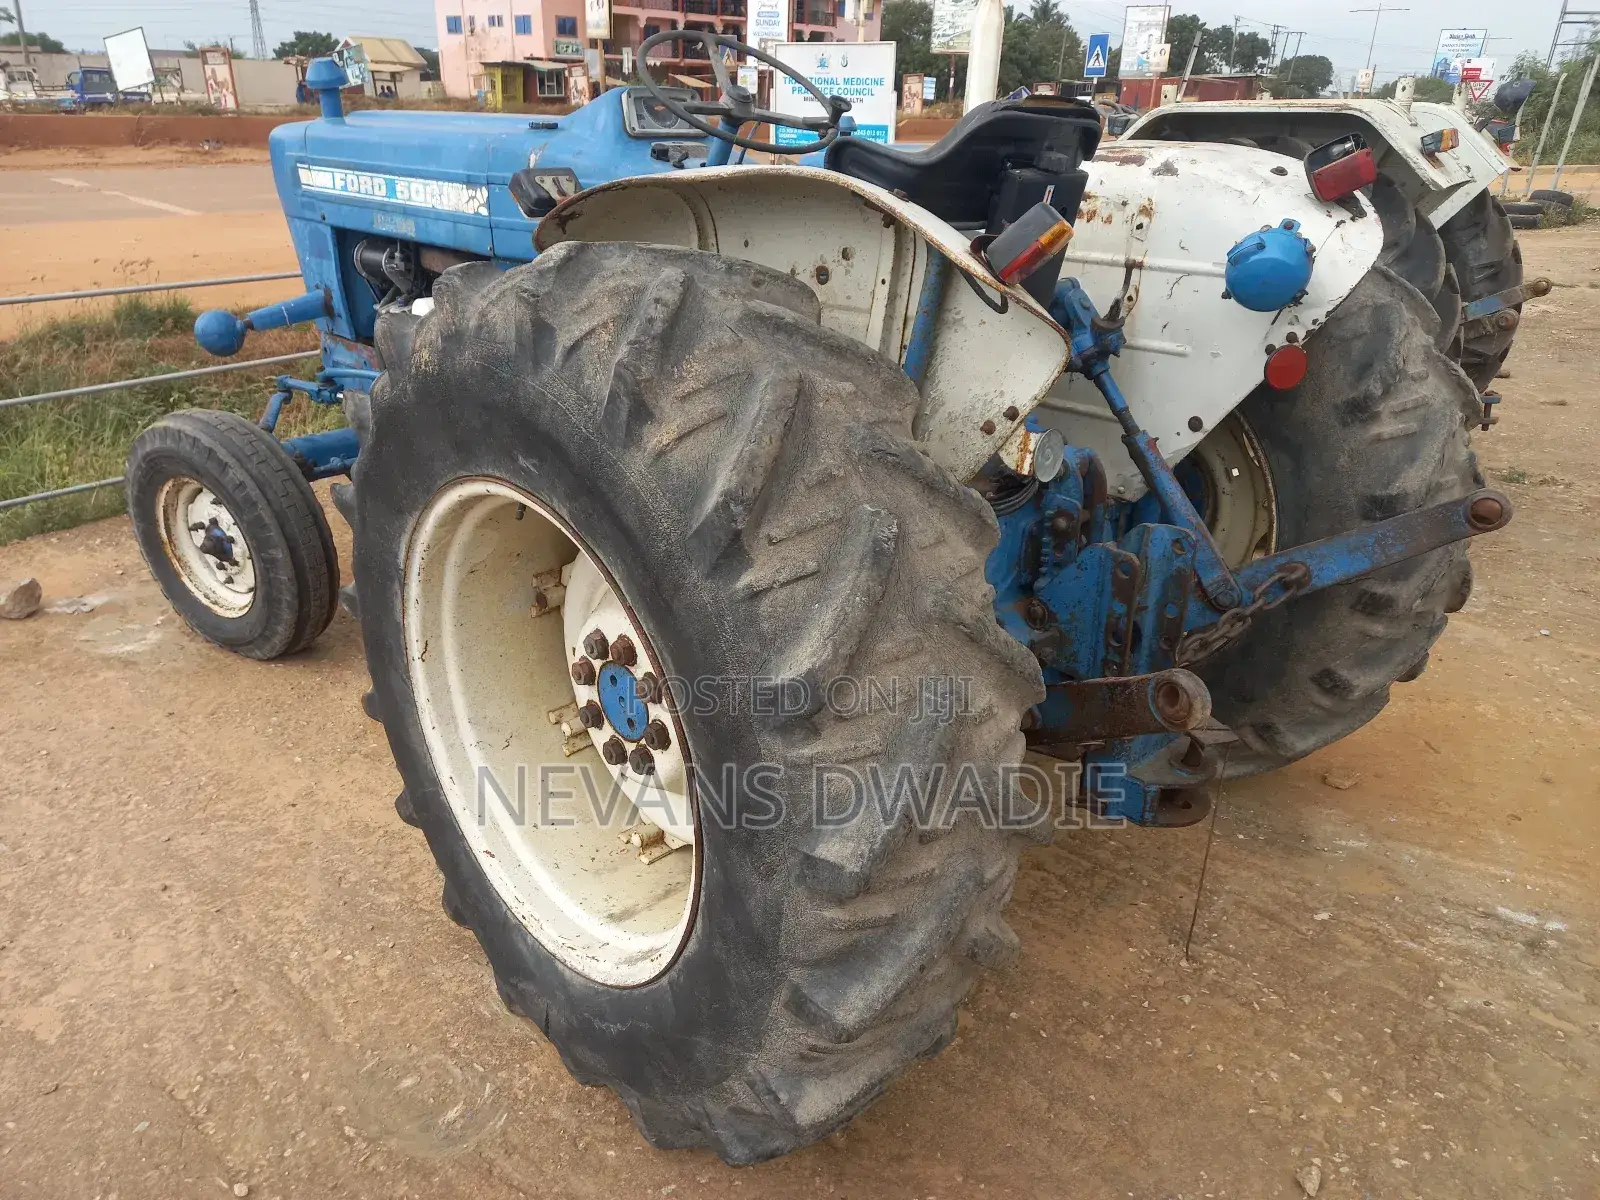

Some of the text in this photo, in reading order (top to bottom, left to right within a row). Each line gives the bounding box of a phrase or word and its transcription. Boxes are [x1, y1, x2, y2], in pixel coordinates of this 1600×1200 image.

[755, 19, 781, 27] SUNDAY
[783, 76, 885, 87] TRTIONAL MEDICINE
[791, 86, 875, 97] PRAICE COUNCIL
[333, 171, 387, 197] FORD
